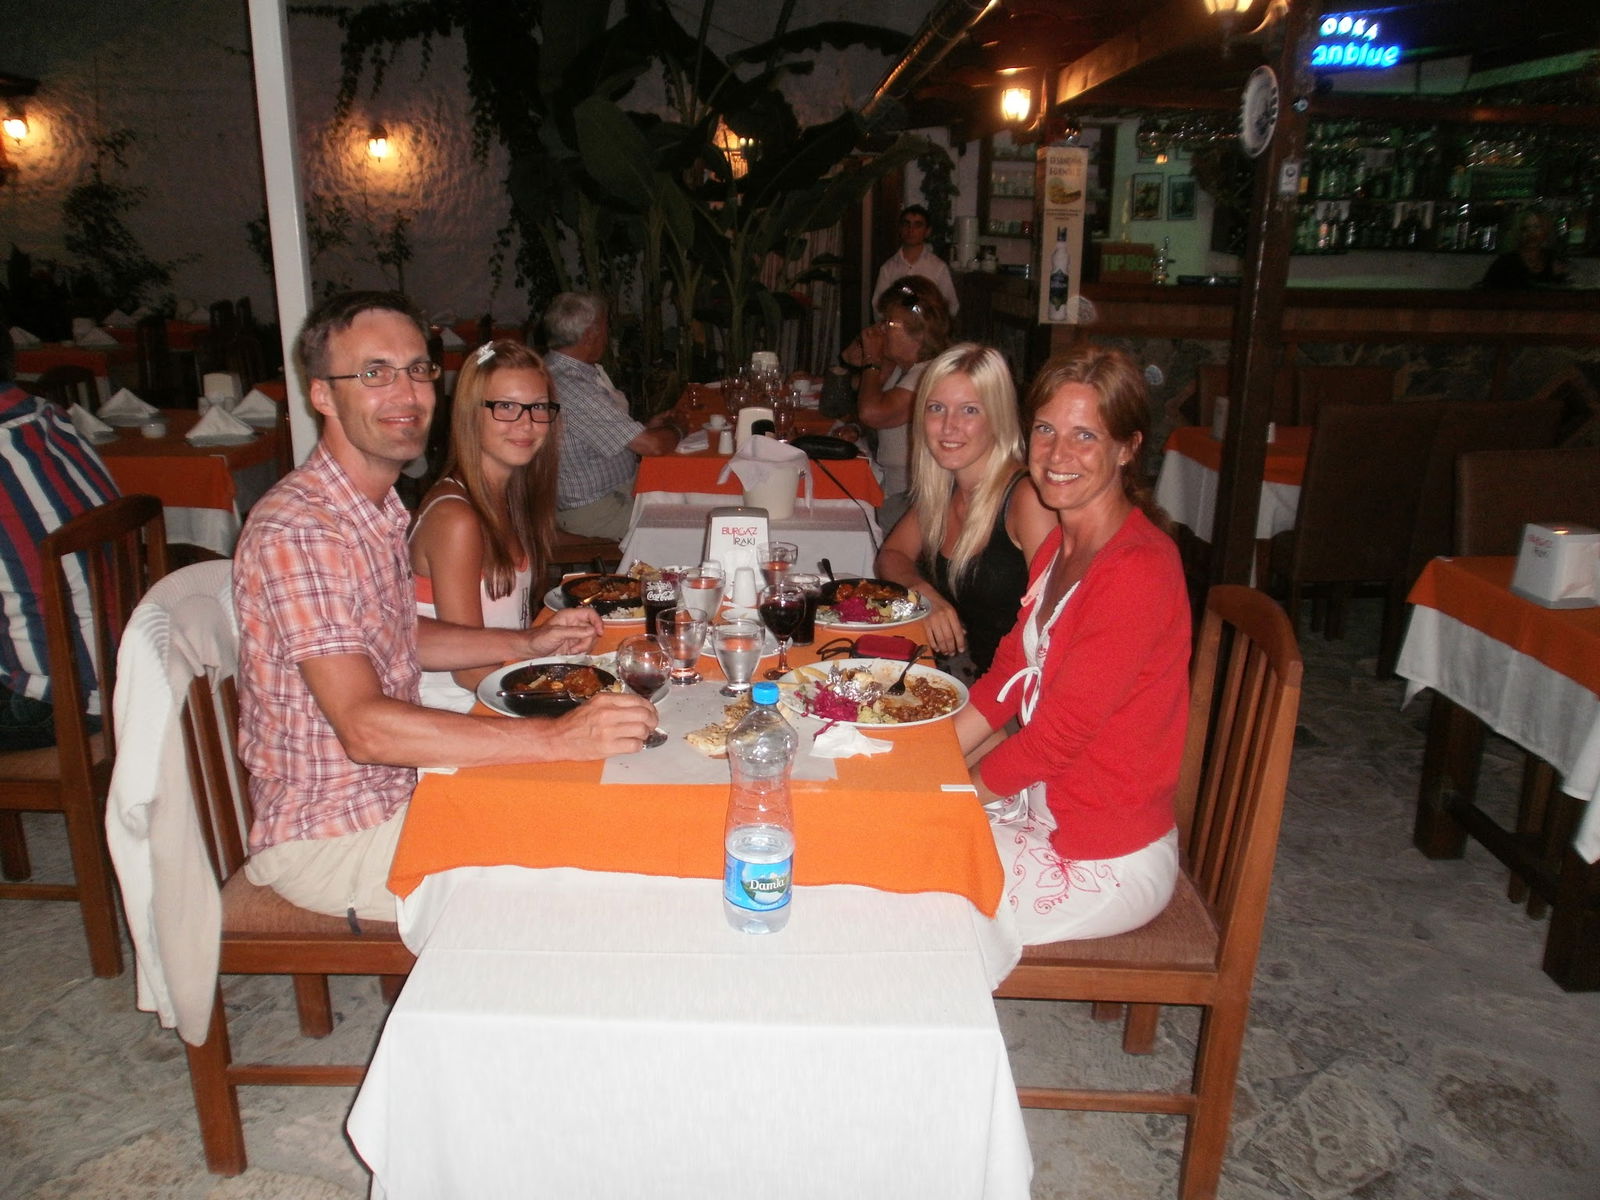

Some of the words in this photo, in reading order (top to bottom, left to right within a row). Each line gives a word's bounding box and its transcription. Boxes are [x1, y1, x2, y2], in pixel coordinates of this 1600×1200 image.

[1319, 16, 1379, 40] ODKA
[1311, 42, 1400, 66] anblue
[721, 527, 757, 537] BURGAZ
[750, 878, 784, 891] Damla
